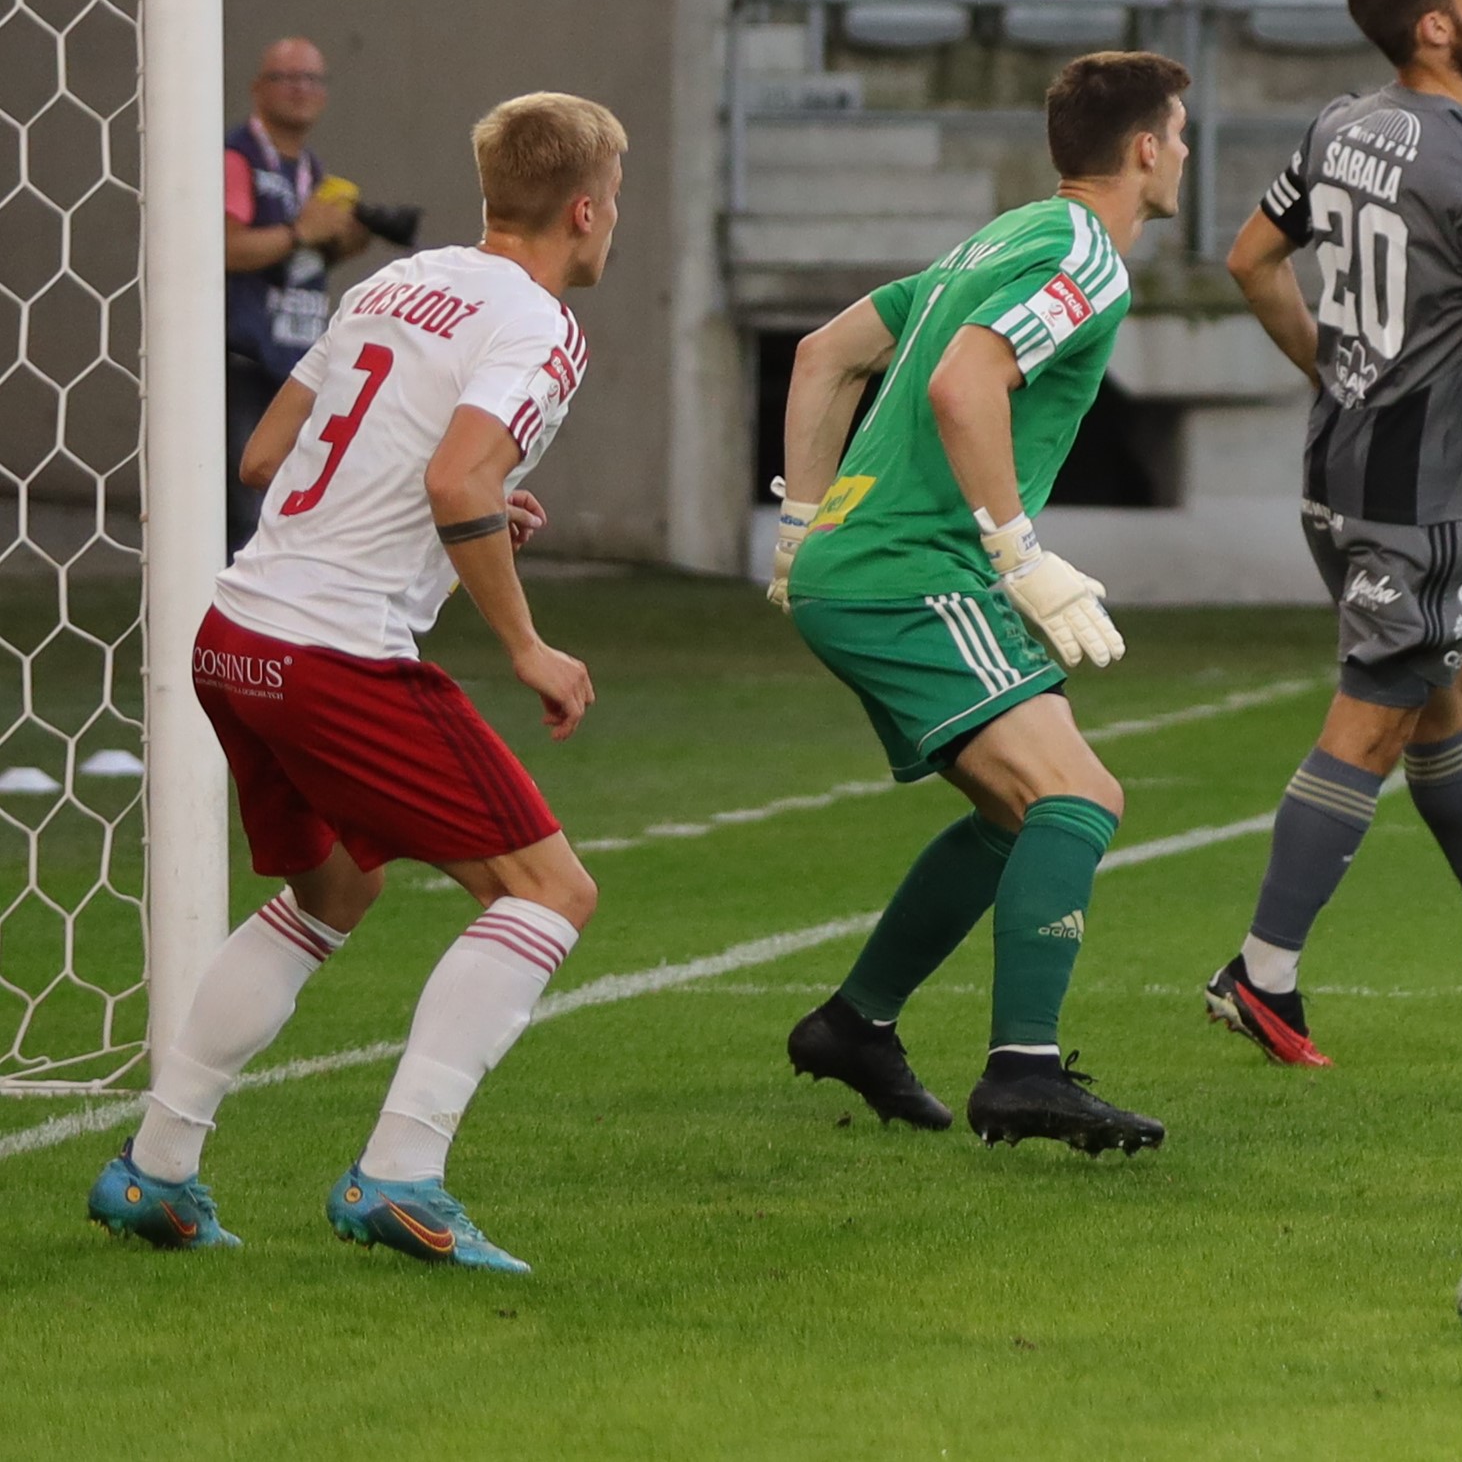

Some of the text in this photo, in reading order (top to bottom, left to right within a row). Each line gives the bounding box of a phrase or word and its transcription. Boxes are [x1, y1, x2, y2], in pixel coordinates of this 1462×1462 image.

[353, 281, 411, 317] ŁKS
[391, 285, 486, 340] ŁÓDŹ
[1309, 182, 1407, 360] 20
[279, 342, 395, 516] 3
[193, 646, 283, 688] COSINUS
